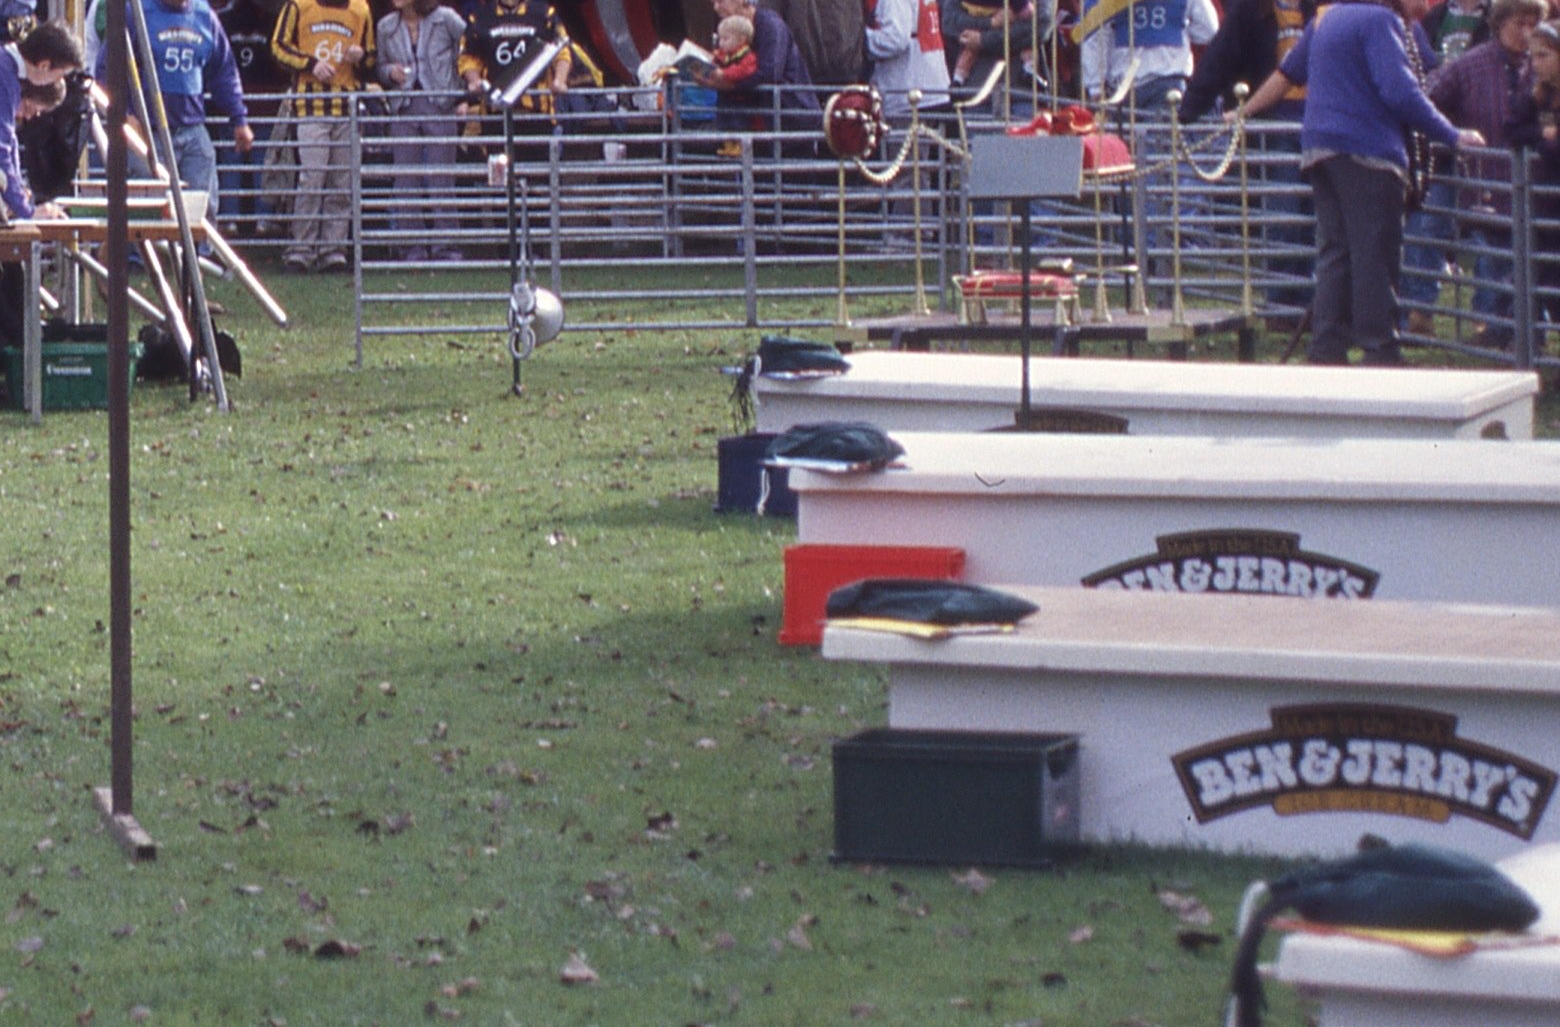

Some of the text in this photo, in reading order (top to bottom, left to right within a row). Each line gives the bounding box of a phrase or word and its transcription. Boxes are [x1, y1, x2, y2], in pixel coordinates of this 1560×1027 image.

[1132, 6, 1166, 29] 38
[164, 47, 195, 71] 55
[240, 47, 254, 67] 9
[315, 39, 344, 63] 64
[495, 39, 526, 65] 64
[1179, 557, 1212, 592] &
[1213, 555, 1366, 599] JERRY'S
[1192, 739, 1538, 822] BEN & JERRY'S
